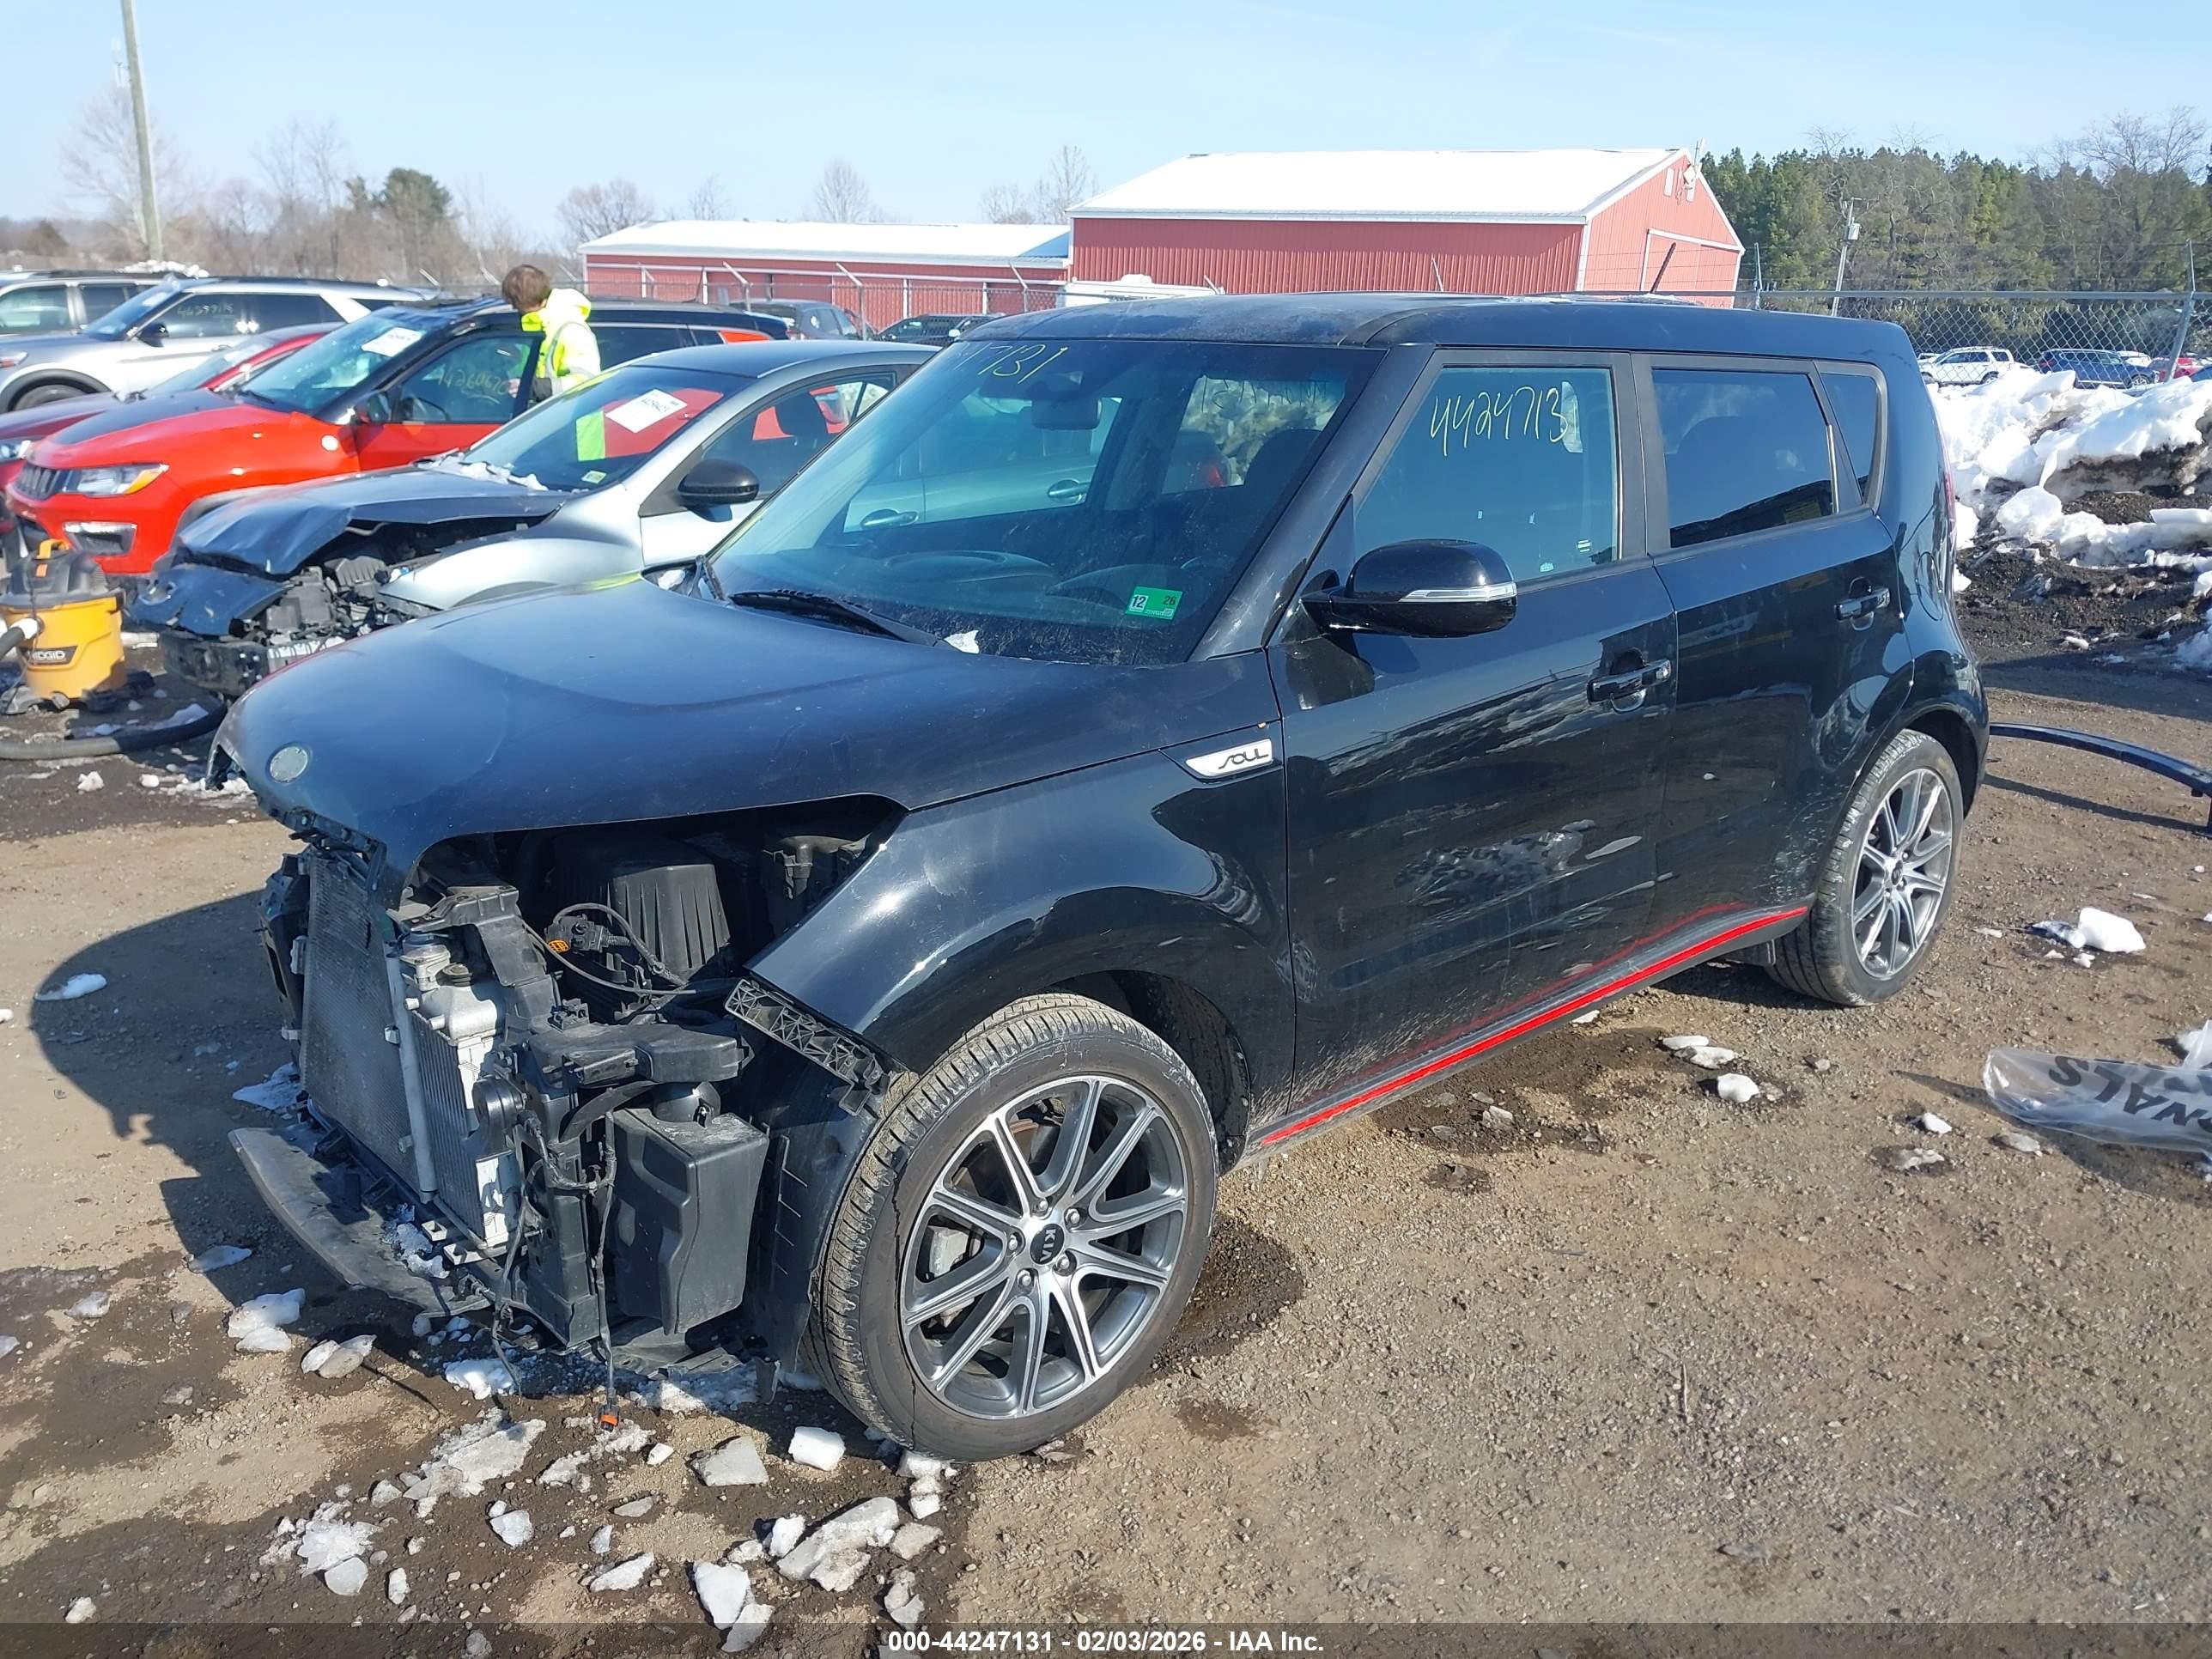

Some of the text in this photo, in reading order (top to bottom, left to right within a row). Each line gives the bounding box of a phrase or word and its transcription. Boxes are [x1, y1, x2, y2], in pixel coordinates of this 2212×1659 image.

[1132, 595, 1176, 608] 12 26
[1040, 1229, 1057, 1262] KIA
